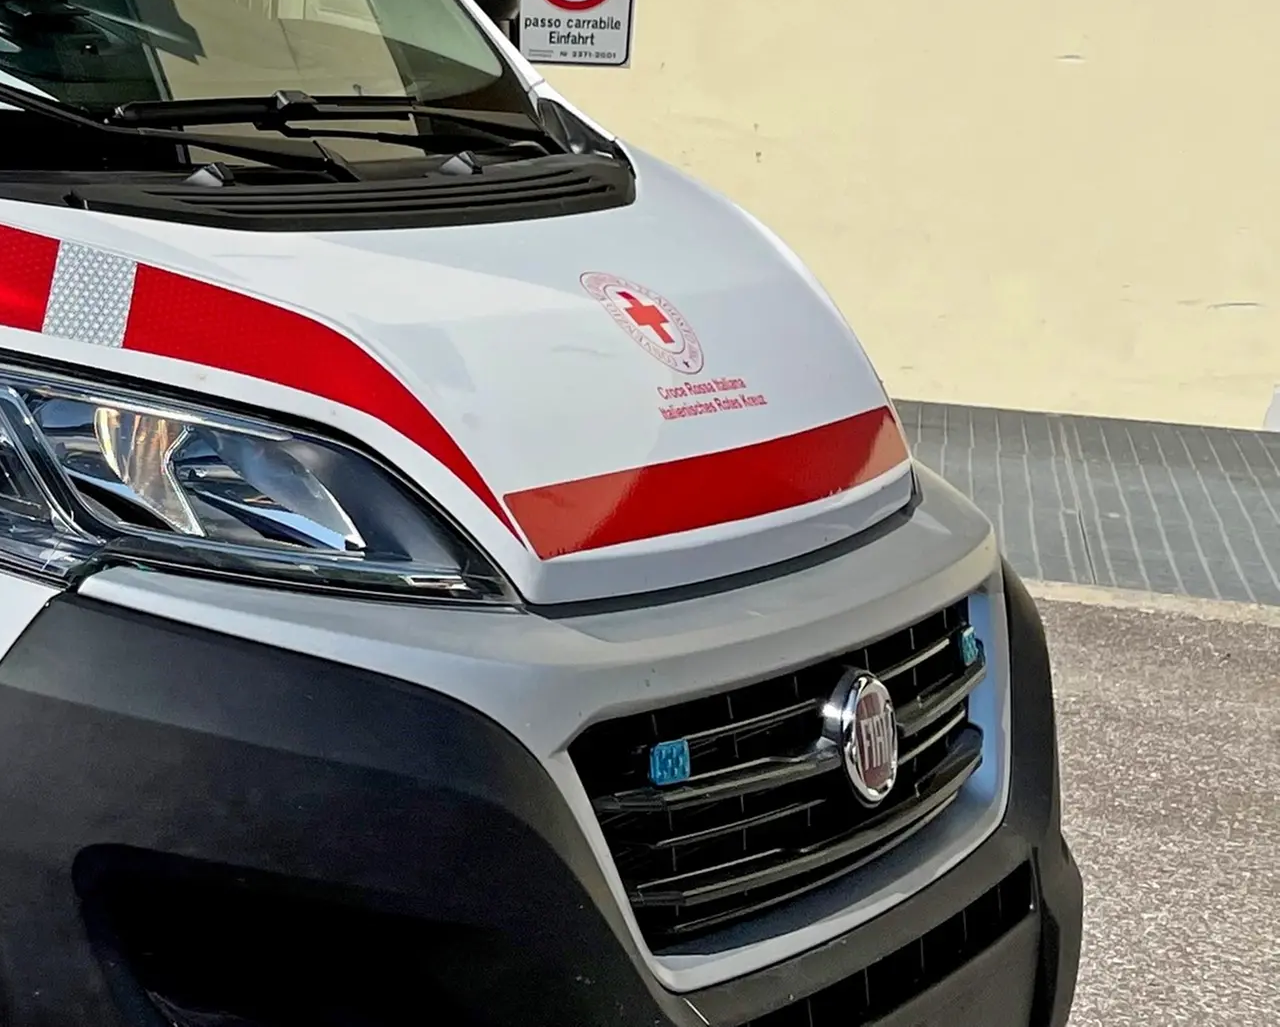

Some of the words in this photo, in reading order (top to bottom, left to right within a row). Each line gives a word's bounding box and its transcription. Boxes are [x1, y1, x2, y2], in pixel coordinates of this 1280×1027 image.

[524, 16, 561, 29] passo
[566, 16, 621, 30] carrabile
[549, 31, 595, 46] Einfahrt
[657, 386, 688, 400] Croce
[683, 381, 717, 396] Rossa
[712, 376, 747, 392] Italiana
[658, 400, 718, 420] Italienisches
[713, 396, 743, 412] Rotes
[739, 394, 768, 407] Kreuz
[860, 710, 893, 771] FIAT
